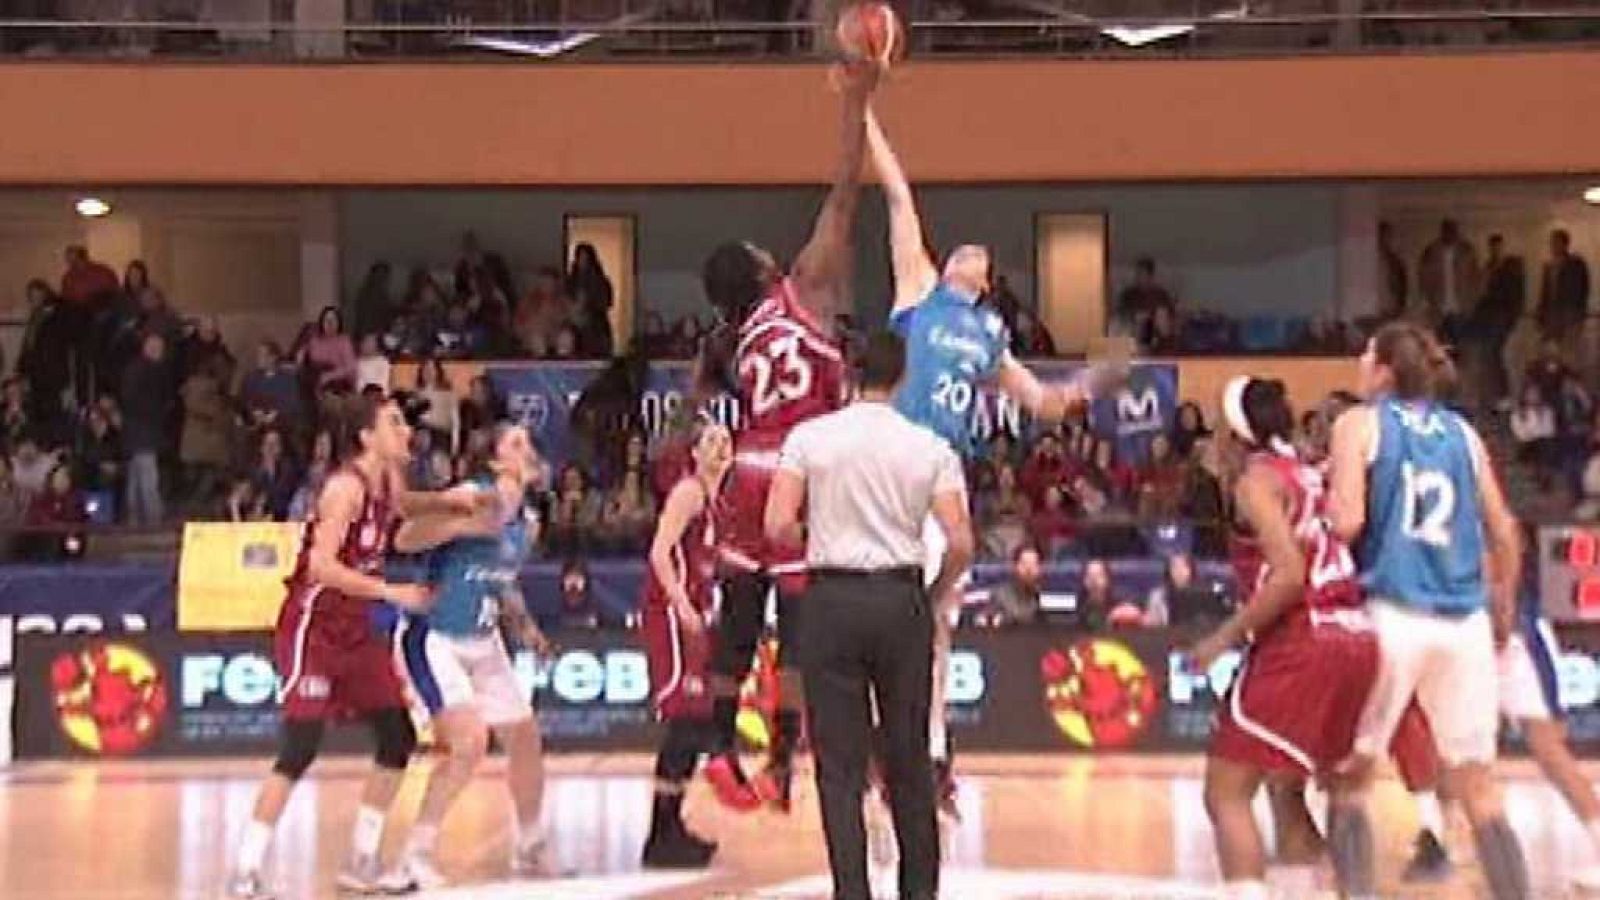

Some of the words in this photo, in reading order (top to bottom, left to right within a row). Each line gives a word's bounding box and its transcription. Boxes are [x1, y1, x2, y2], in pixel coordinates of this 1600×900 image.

[738, 335, 812, 415] 23
[931, 374, 972, 413] 20
[1401, 460, 1454, 547] 12
[181, 653, 284, 707] Fe
